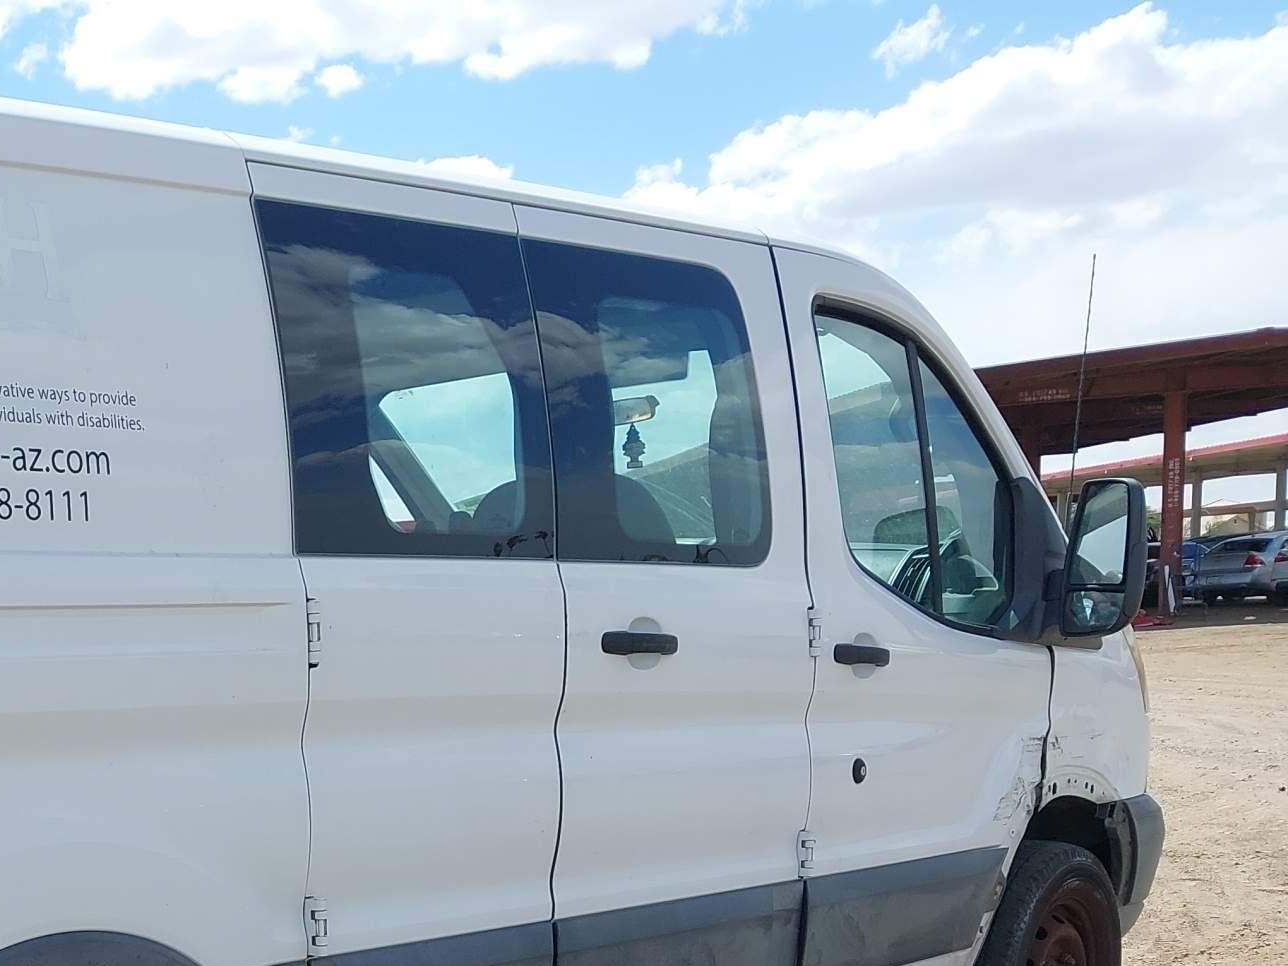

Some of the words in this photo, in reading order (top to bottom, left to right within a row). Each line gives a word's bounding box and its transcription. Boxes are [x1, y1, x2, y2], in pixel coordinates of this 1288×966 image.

[37, 387, 71, 405] ways
[72, 388, 87, 403] to
[89, 390, 137, 408] provide
[44, 409, 74, 427] with
[76, 410, 146, 432] disabilities.
